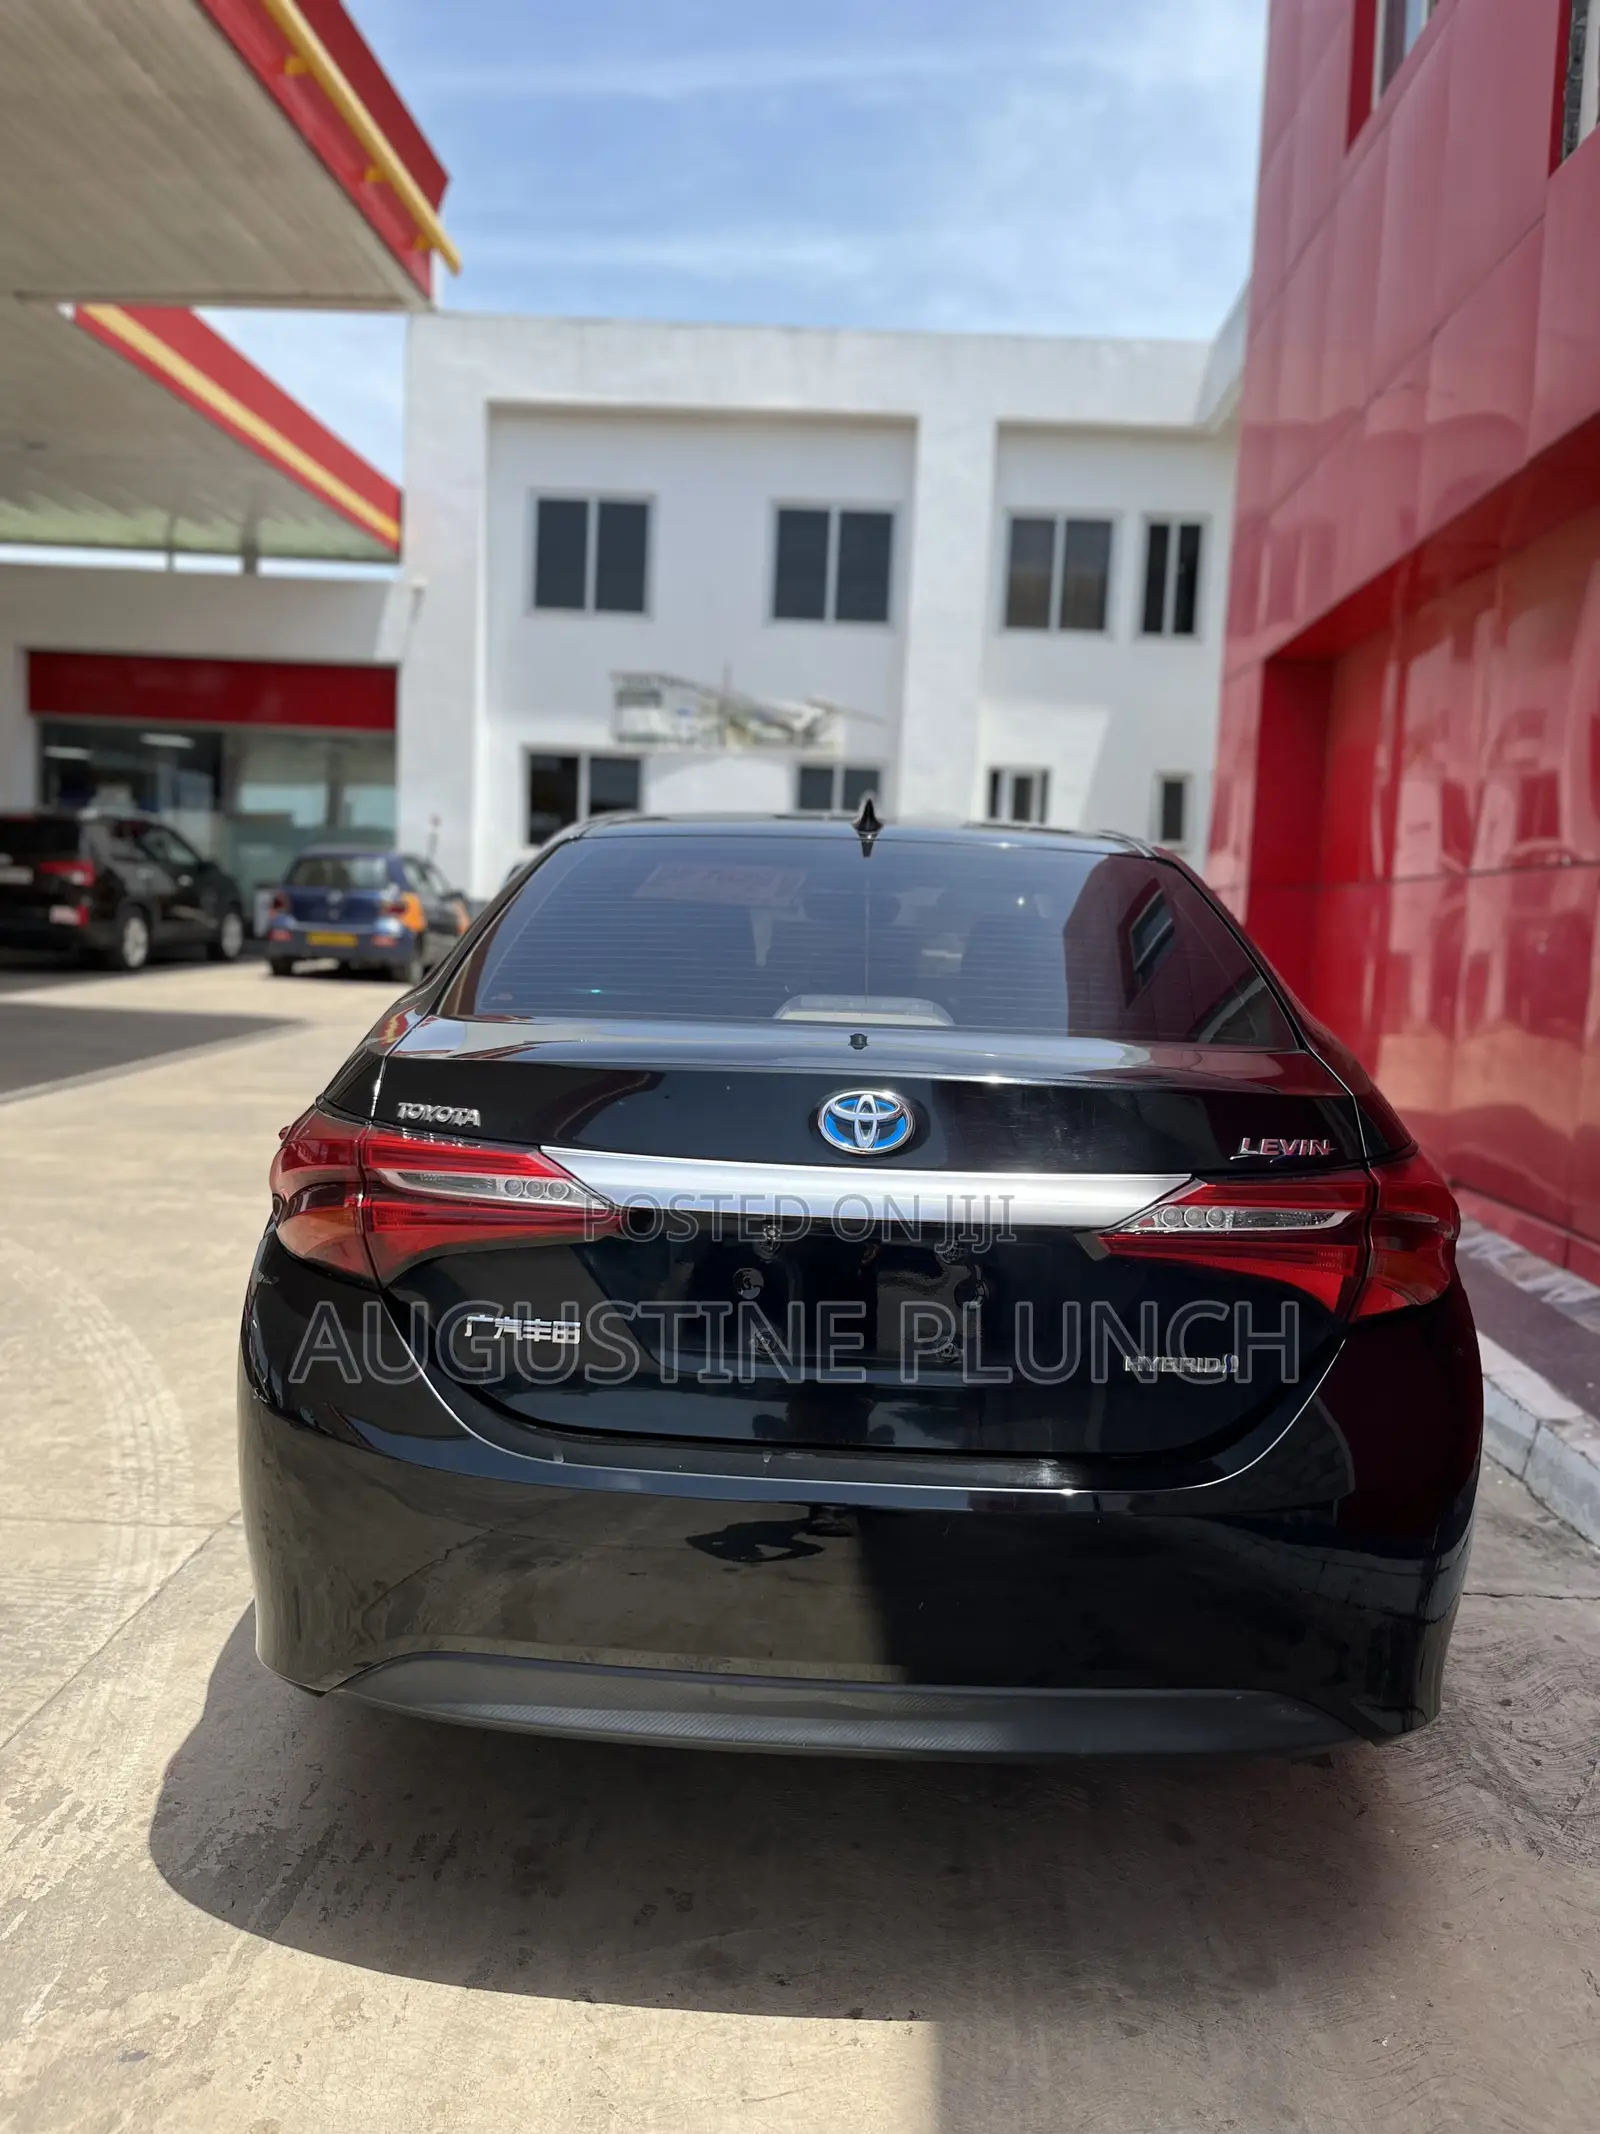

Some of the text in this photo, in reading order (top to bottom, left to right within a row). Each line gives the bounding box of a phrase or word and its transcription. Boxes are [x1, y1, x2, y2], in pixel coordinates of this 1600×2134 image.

[397, 1102, 481, 1127] TOYOTA
[1239, 1137, 1331, 1156] LEVIN
[464, 1314, 581, 1344] 广汽丰田
[1124, 1355, 1222, 1374] HYBRID
